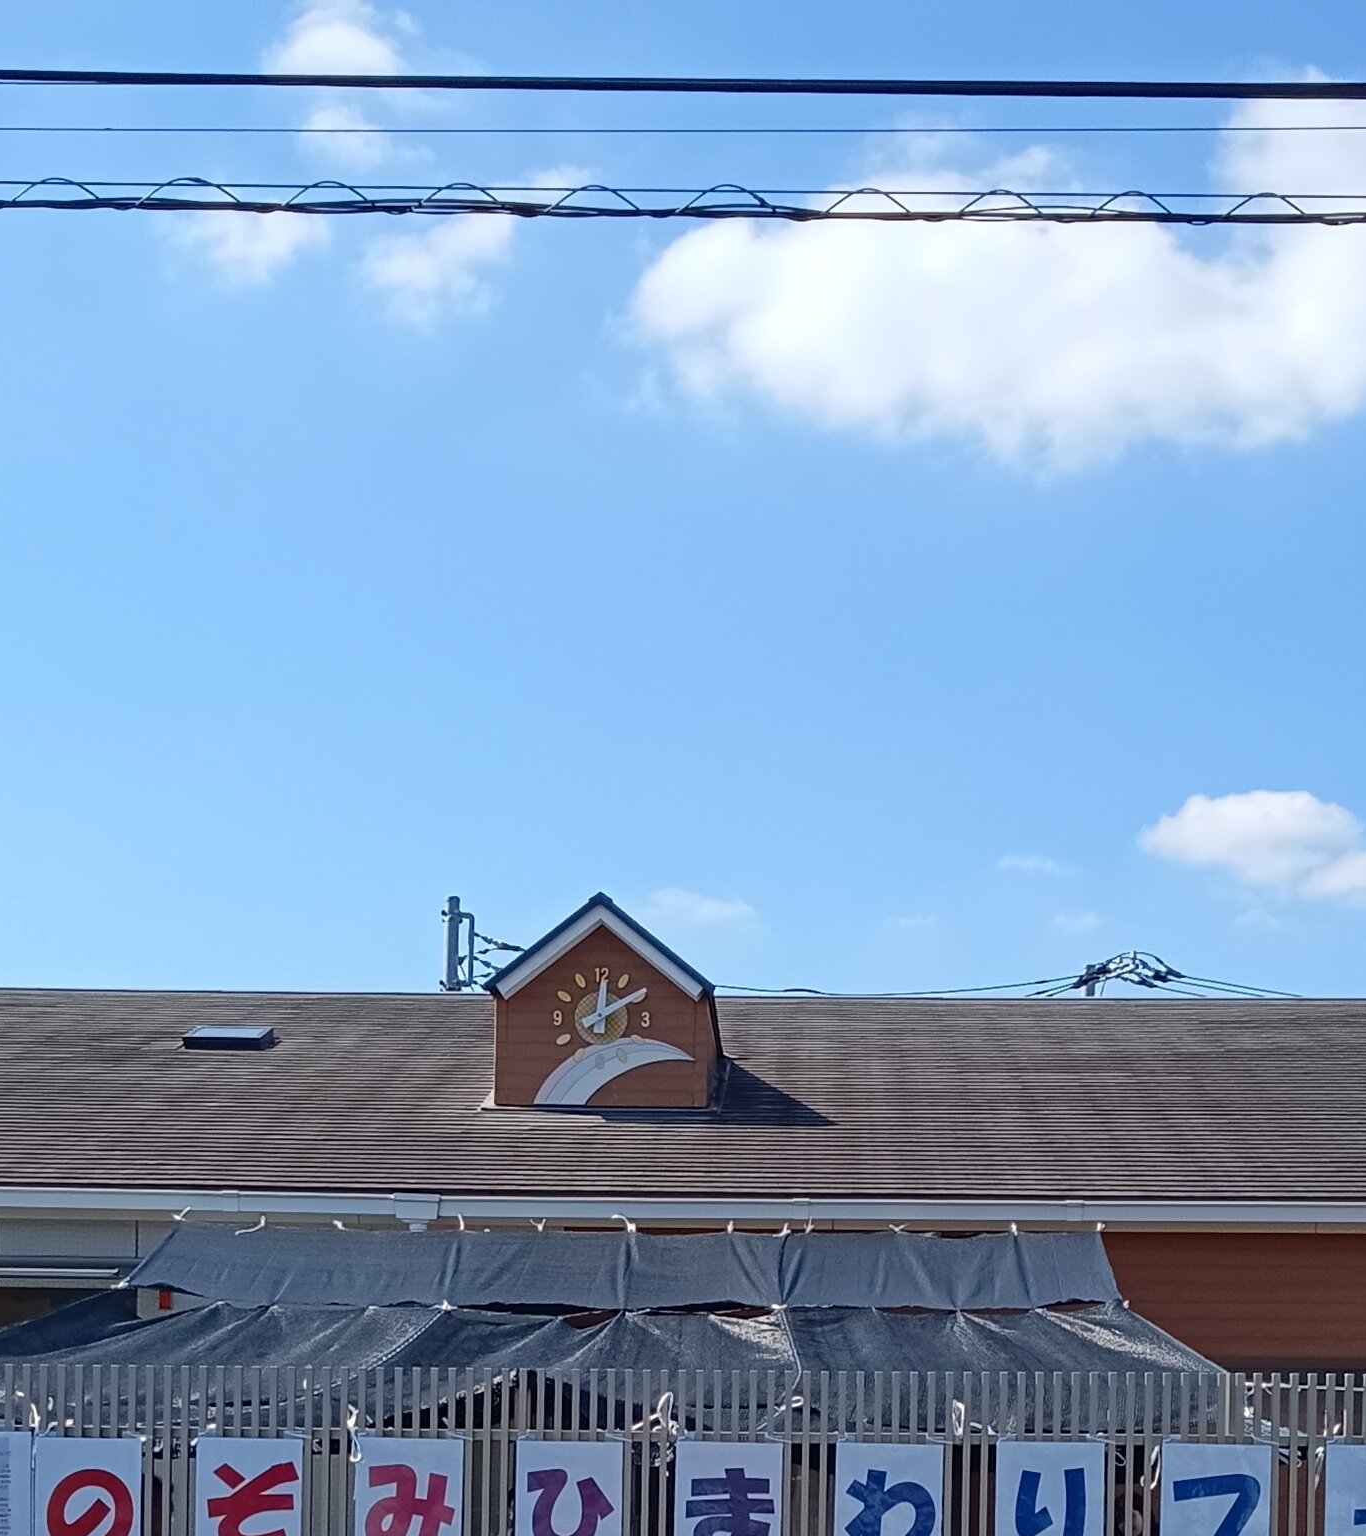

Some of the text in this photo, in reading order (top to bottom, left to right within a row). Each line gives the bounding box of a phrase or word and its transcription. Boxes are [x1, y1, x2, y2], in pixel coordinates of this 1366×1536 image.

[595, 967, 609, 982] 12
[553, 1010, 562, 1026] 9
[641, 1011, 650, 1028] 3
